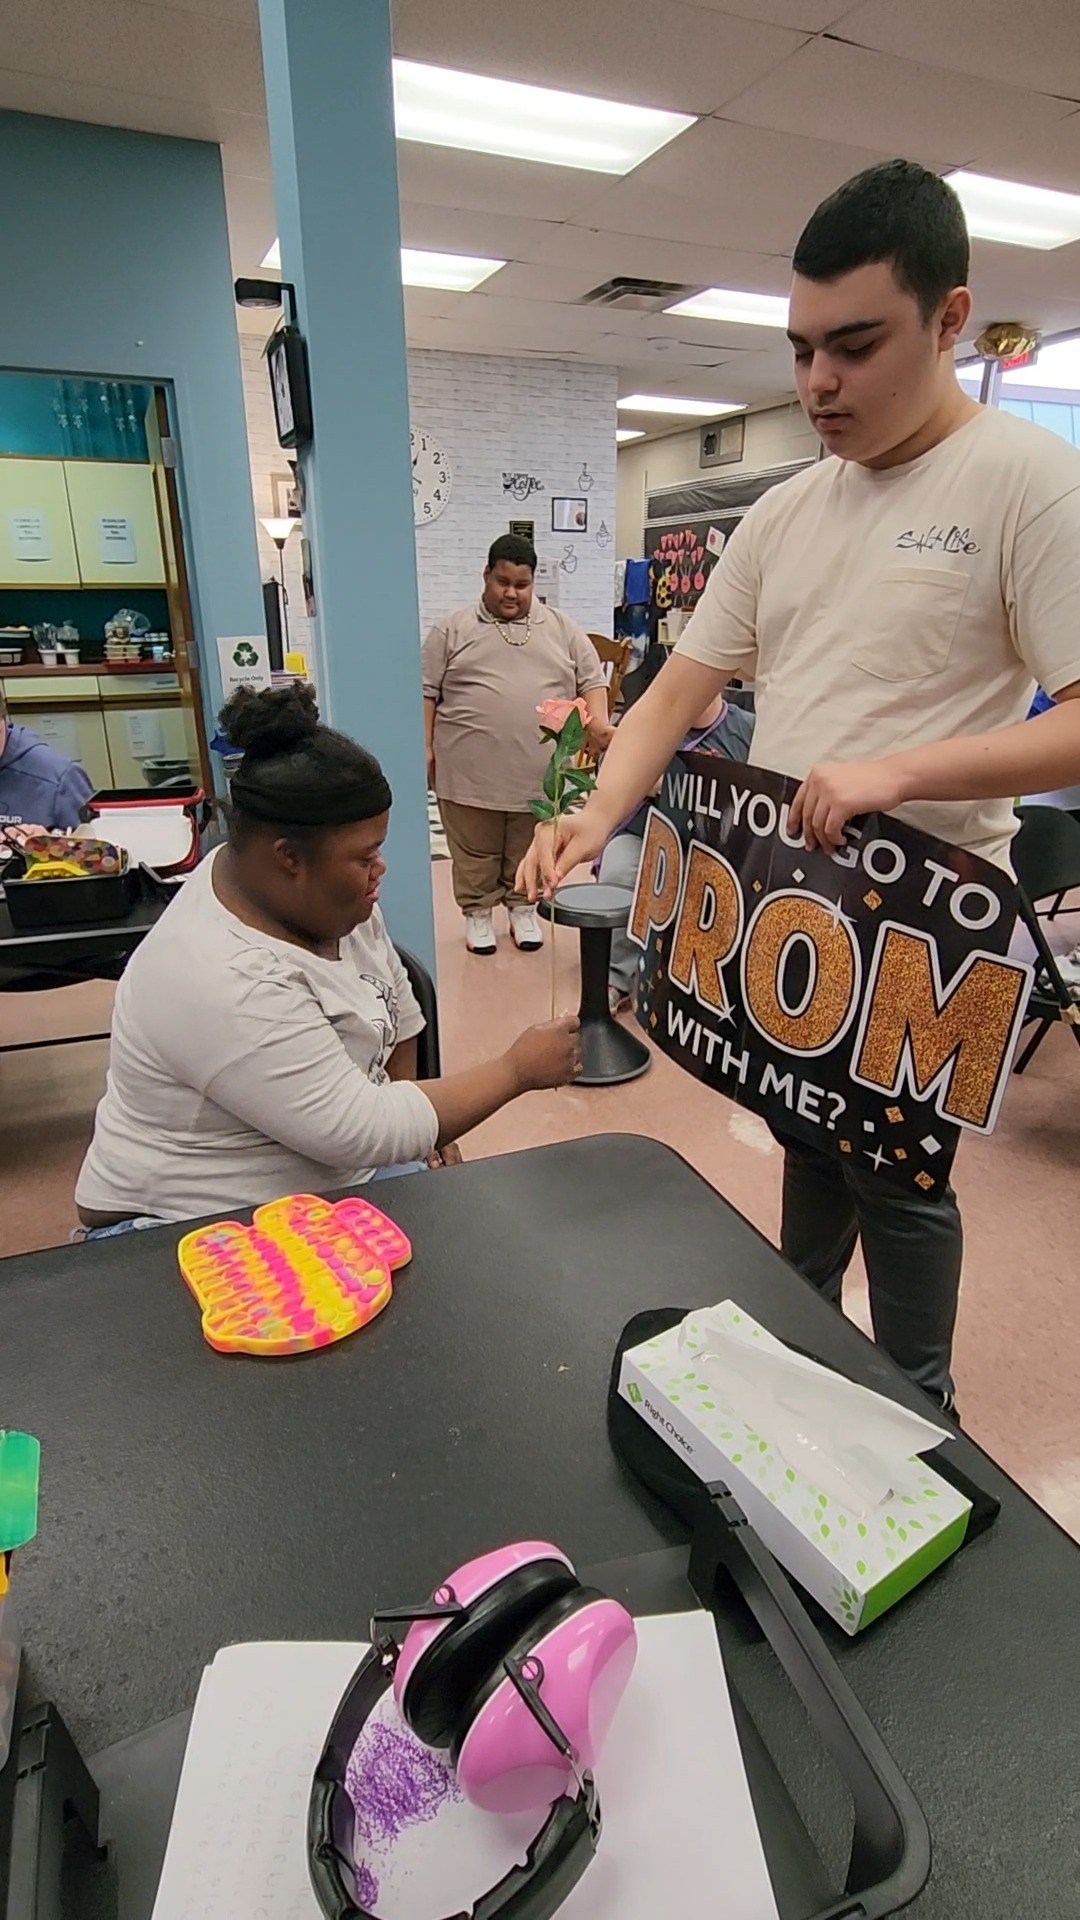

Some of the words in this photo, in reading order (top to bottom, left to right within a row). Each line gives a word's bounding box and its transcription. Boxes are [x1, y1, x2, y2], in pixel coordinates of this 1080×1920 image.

[421, 438, 427, 451] 1
[433, 452, 441, 465] 2
[439, 471, 447, 484] 3
[433, 489, 442, 501] 4
[423, 502, 431, 514] 5
[229, 676, 250, 684] Recycle
[666, 772, 722, 820] WILL
[730, 785, 806, 849] YOU
[830, 825, 906, 884] GO
[922, 858, 1001, 931] TO
[627, 805, 1035, 1136] PROM
[667, 1001, 750, 1085] WITH
[758, 1063, 847, 1131] ME?
[644, 1399, 665, 1427] Right
[665, 1421, 694, 1455] Choice
